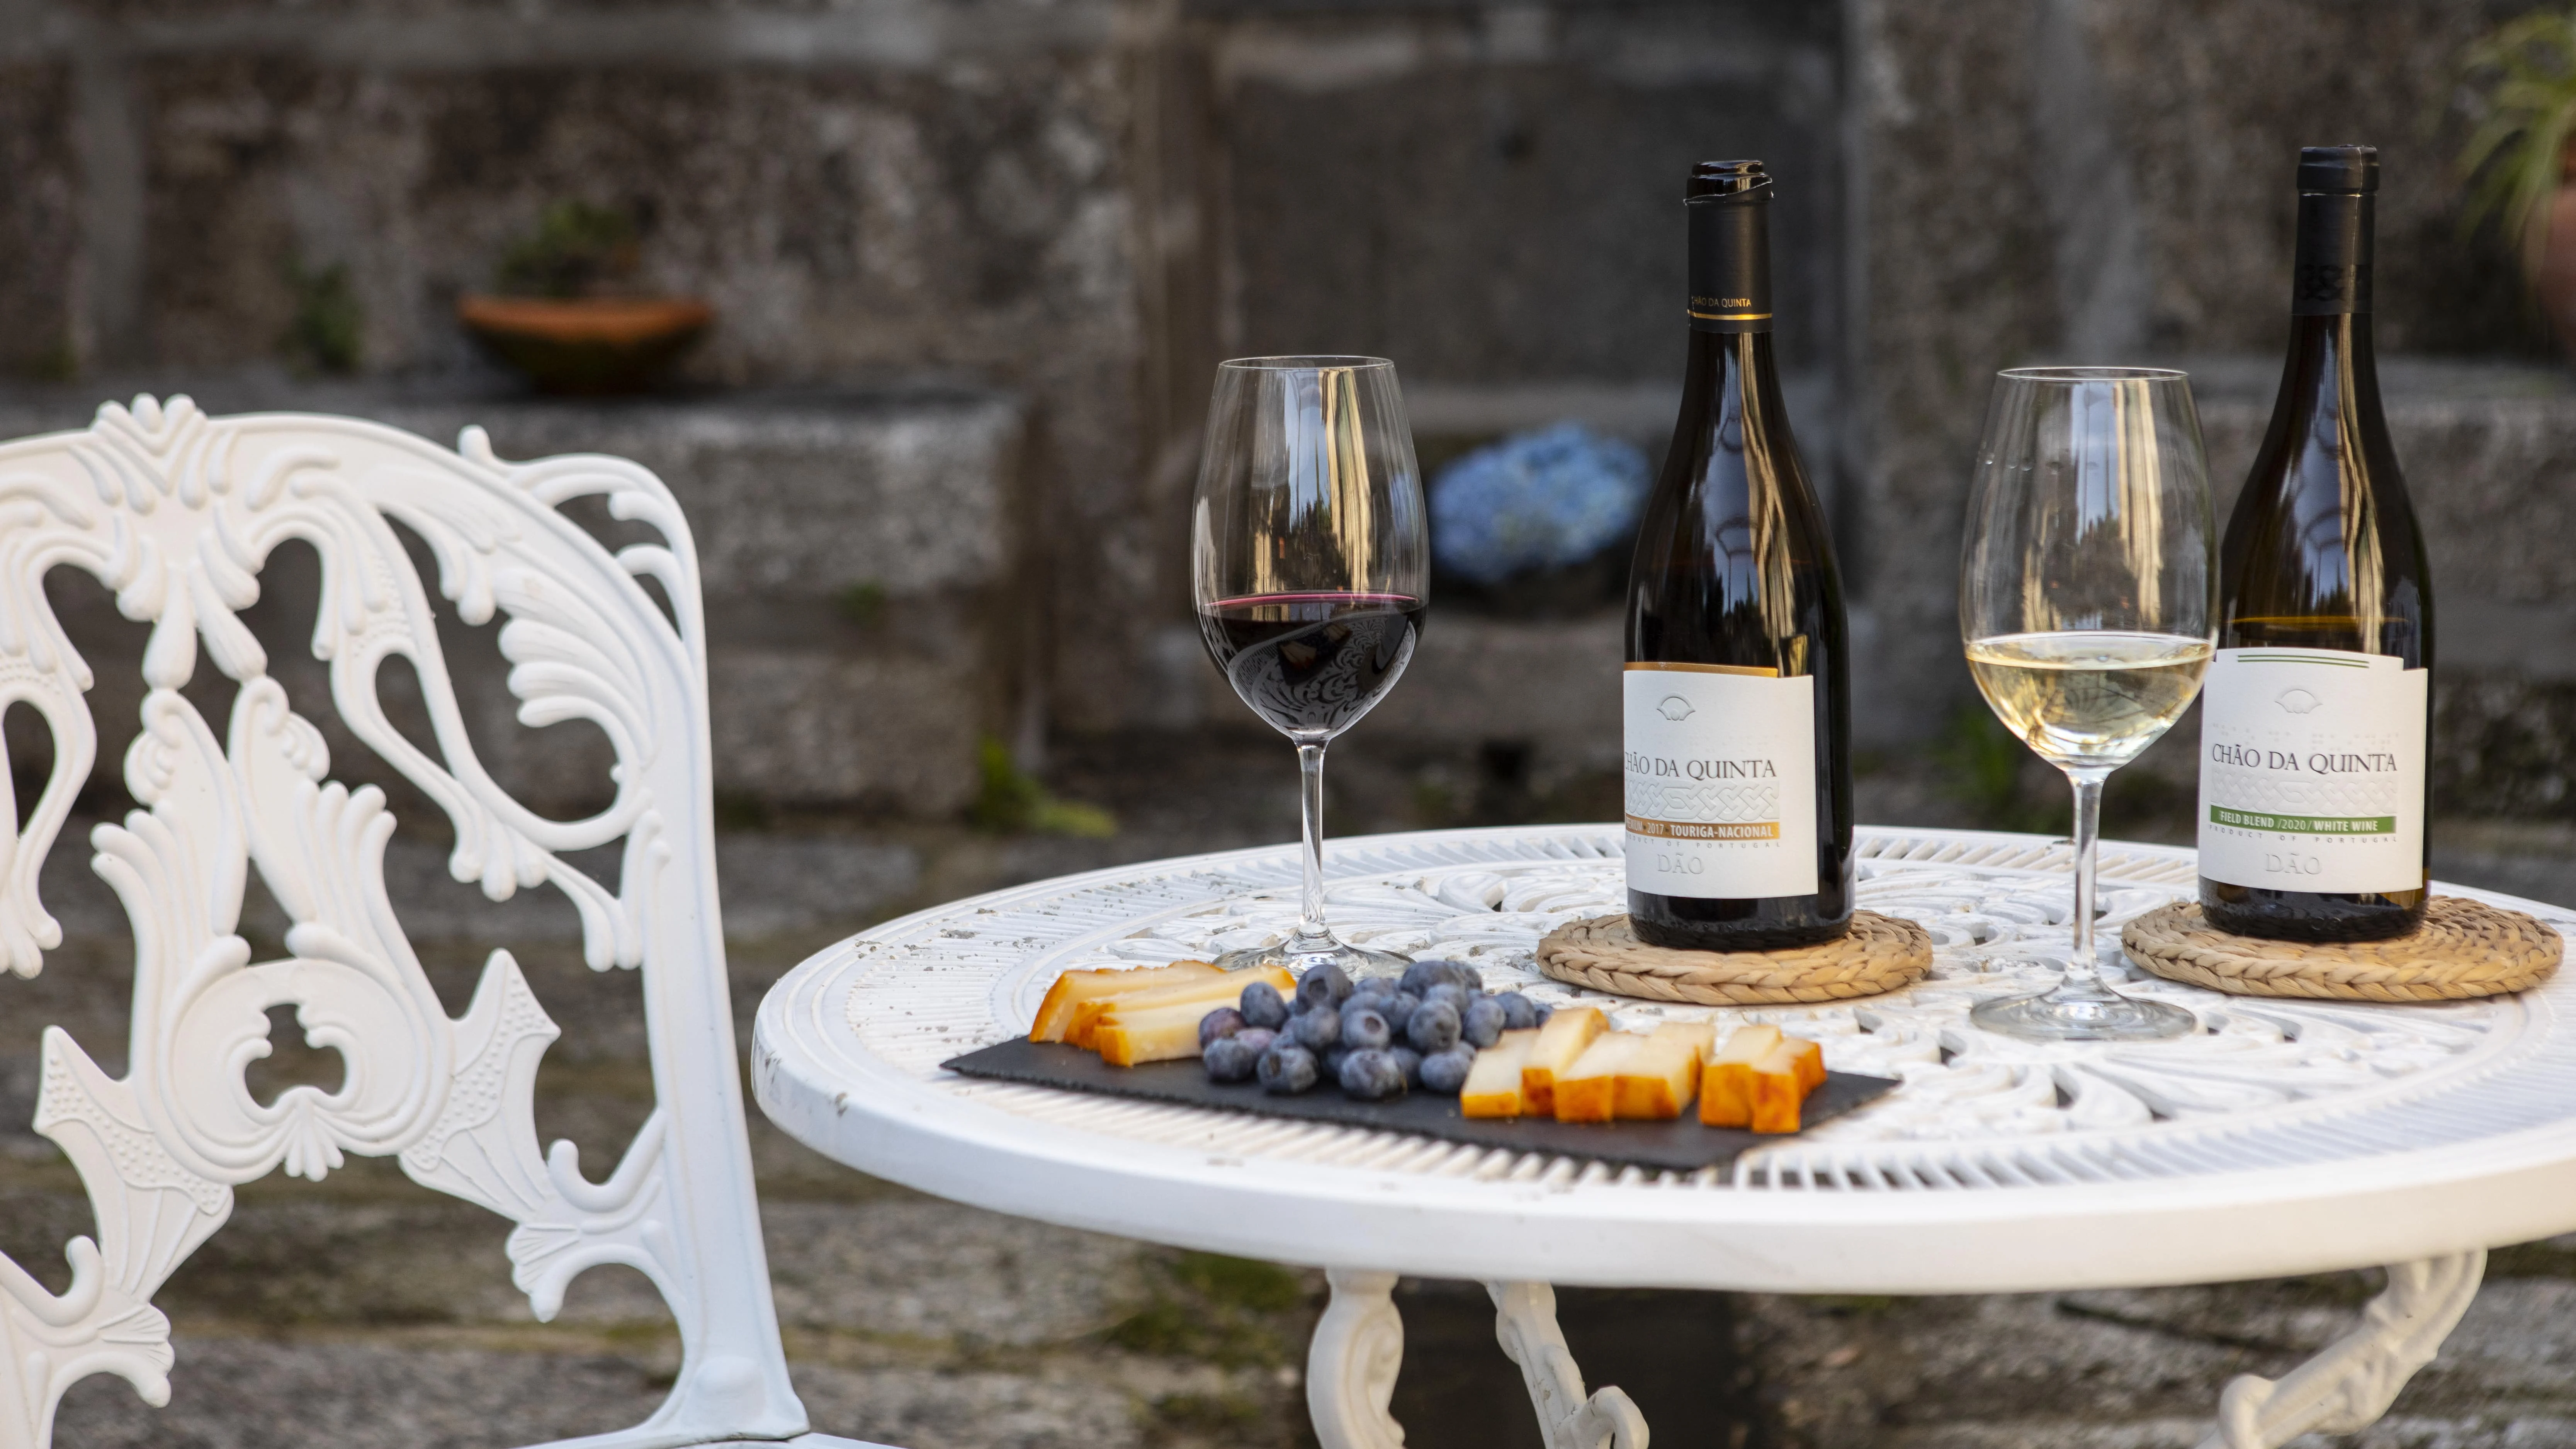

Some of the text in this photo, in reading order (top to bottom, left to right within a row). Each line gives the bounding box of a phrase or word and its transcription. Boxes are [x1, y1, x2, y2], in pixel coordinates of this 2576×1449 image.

[1693, 296, 1752, 308] HÃO DA QUINTA
[1655, 758, 1680, 777] DA
[1687, 759, 1777, 781] QUINTA
[2212, 744, 2398, 775] CHÃO DA QUINTA
[1647, 822, 1665, 835] 2017
[1670, 824, 1774, 838] TOURIGA-NACIONAL
[2209, 824, 2263, 839] PRODUCT
[2220, 811, 2241, 824] FIELD
[2243, 814, 2274, 828] BLEND
[2313, 820, 2349, 832] WHITE
[2351, 820, 2378, 831] WINE
[1657, 852, 1705, 874] DÃO
[2265, 853, 2323, 875] DÃO
